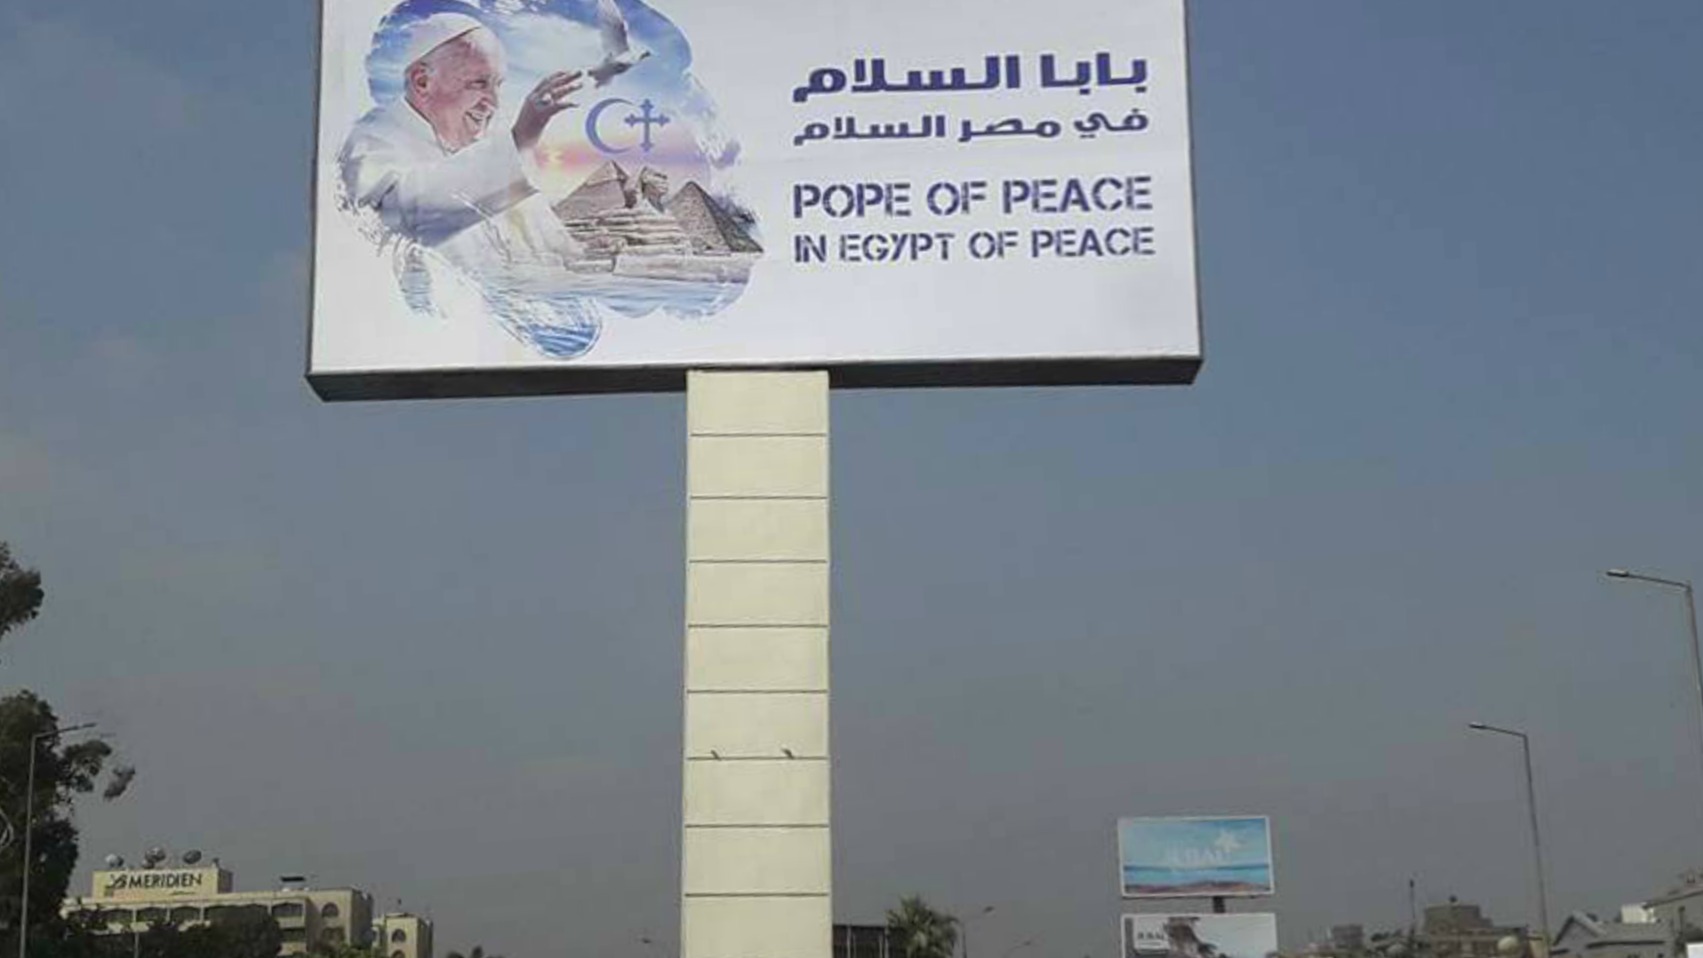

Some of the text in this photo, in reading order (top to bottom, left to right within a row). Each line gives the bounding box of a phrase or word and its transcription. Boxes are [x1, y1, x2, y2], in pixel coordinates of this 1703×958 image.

[793, 52, 1148, 103] بابا السلام
[794, 108, 1150, 146] في مصر السلام
[794, 176, 1153, 218] POPE OF PEACE
[794, 227, 1155, 262] IN EGYPT OF PEACE
[129, 872, 202, 888] MERIDIEN
